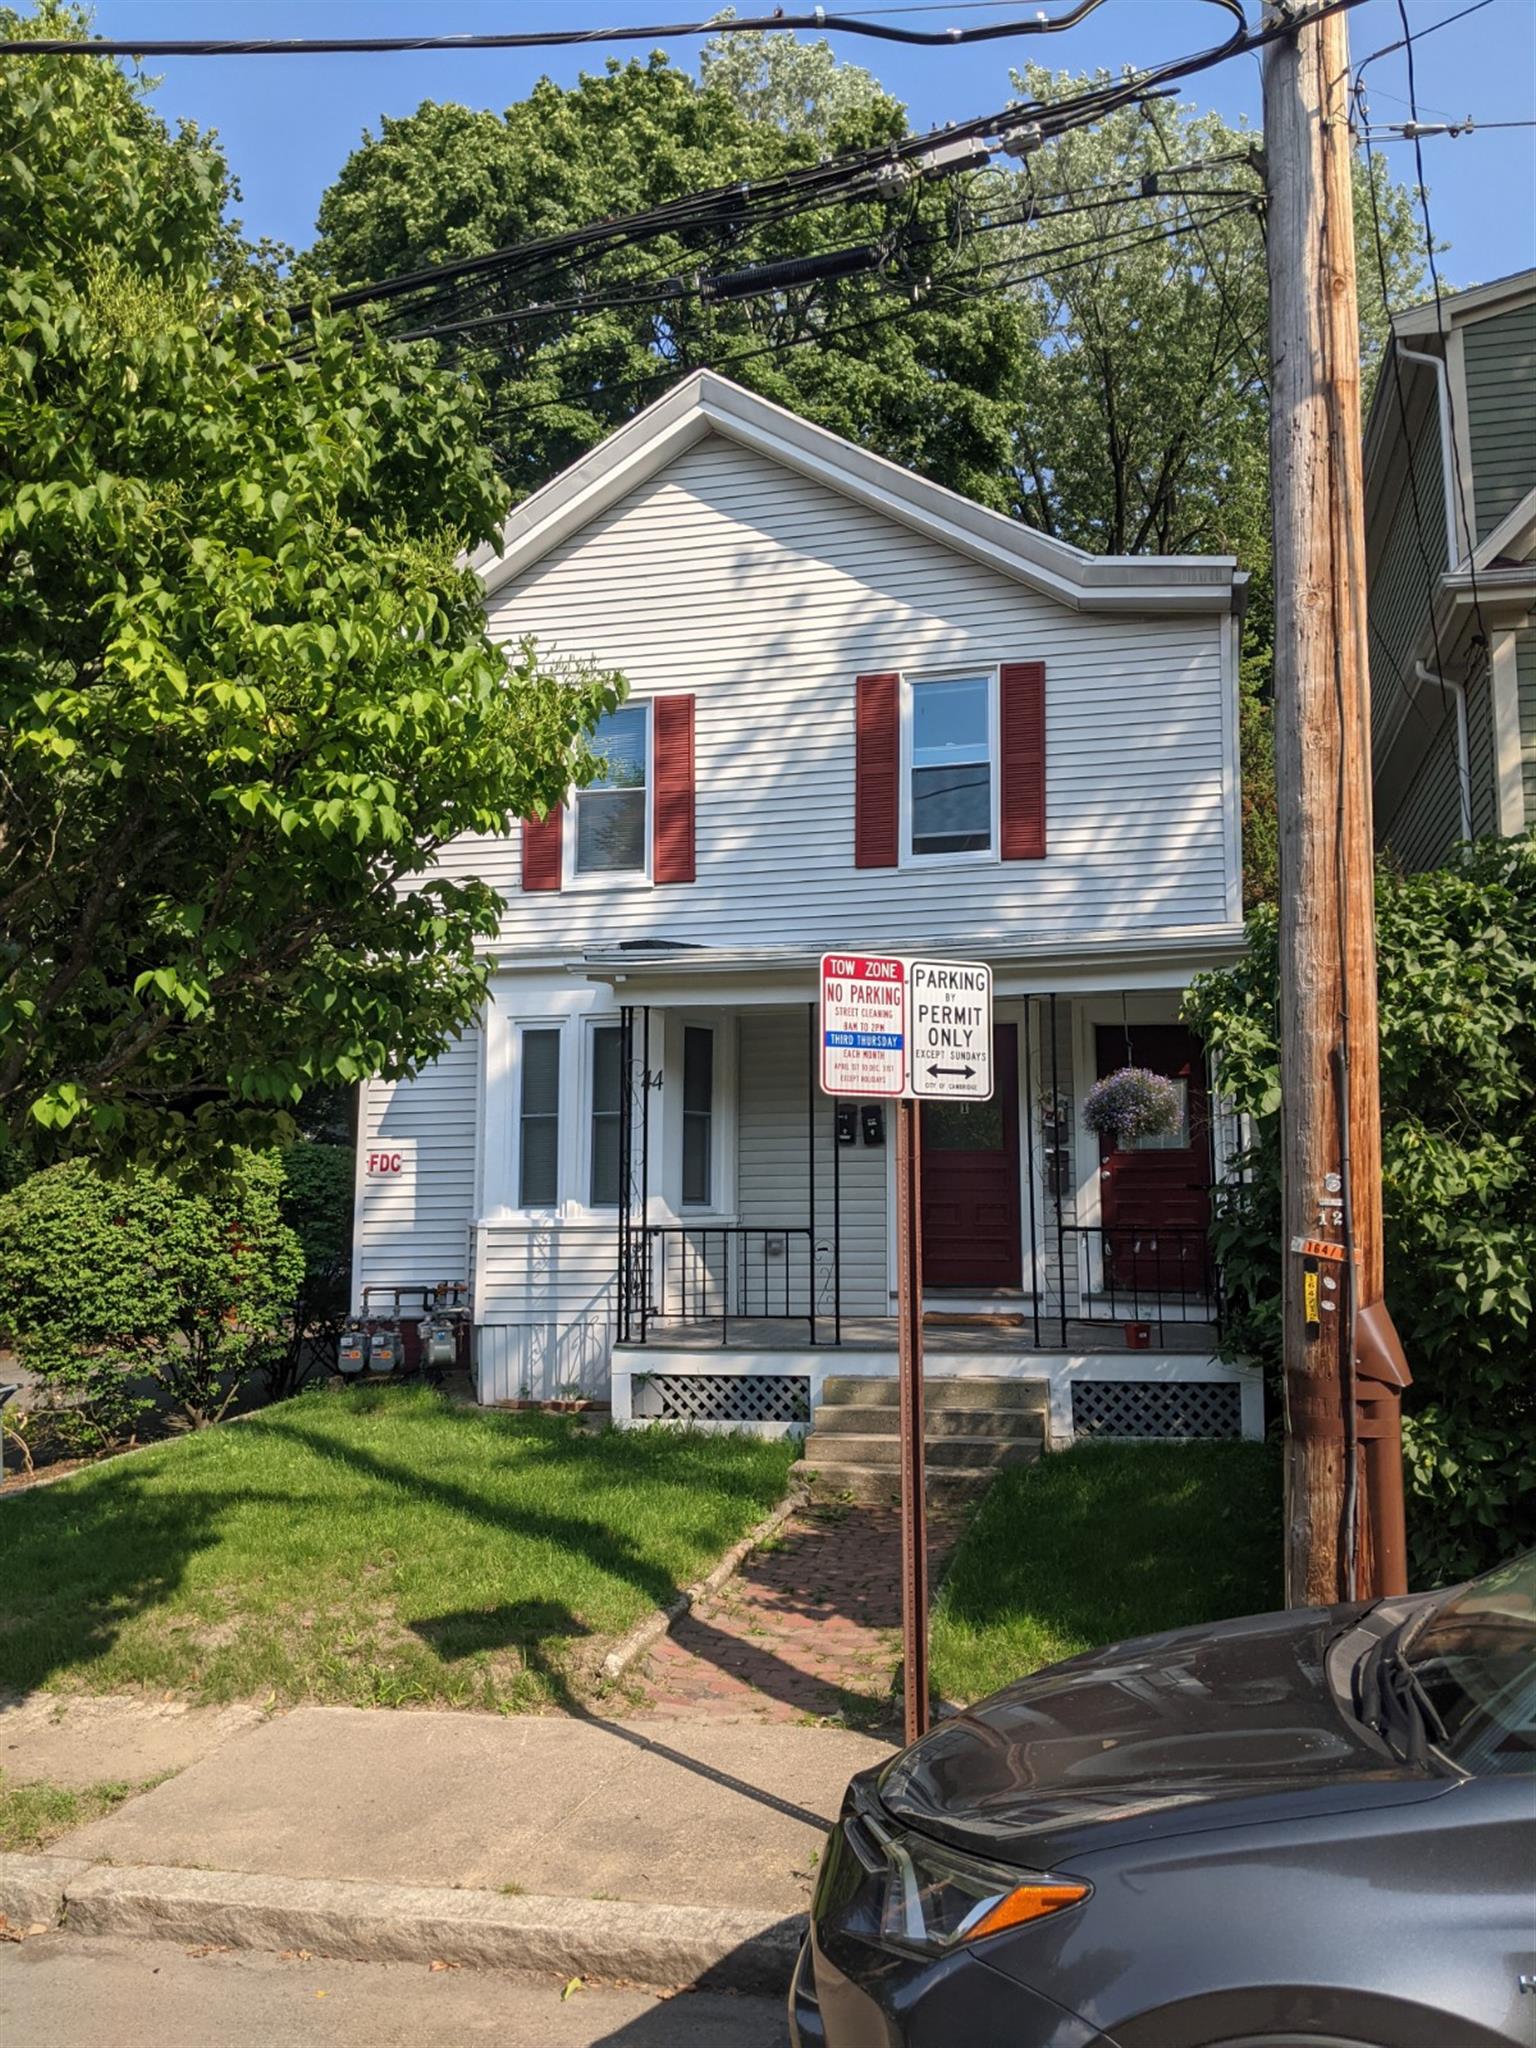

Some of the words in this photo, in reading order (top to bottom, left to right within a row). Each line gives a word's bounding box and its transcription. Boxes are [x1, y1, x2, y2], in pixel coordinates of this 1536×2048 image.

[830, 959, 855, 976] TOW
[865, 961, 898, 979] ZONE
[916, 969, 985, 991] PARKING
[827, 983, 843, 1002] NO
[850, 984, 901, 1006] PARKING
[945, 993, 956, 1002] BY
[835, 1007, 858, 1017] STREET
[861, 1008, 893, 1019] CLEANING
[919, 1004, 982, 1026] PERMIT
[860, 1022, 868, 1031] TO
[871, 1023, 885, 1032] 2PM
[830, 1033, 854, 1046] THIRD
[857, 1034, 898, 1048] THURSDAY
[928, 1027, 973, 1047] ONLY
[843, 1049, 860, 1058] EACH
[863, 1050, 885, 1060] MONTH
[916, 1049, 945, 1060] EXCEPT
[950, 1050, 986, 1062] SUNDAYS
[370, 1153, 401, 1172] FDC
